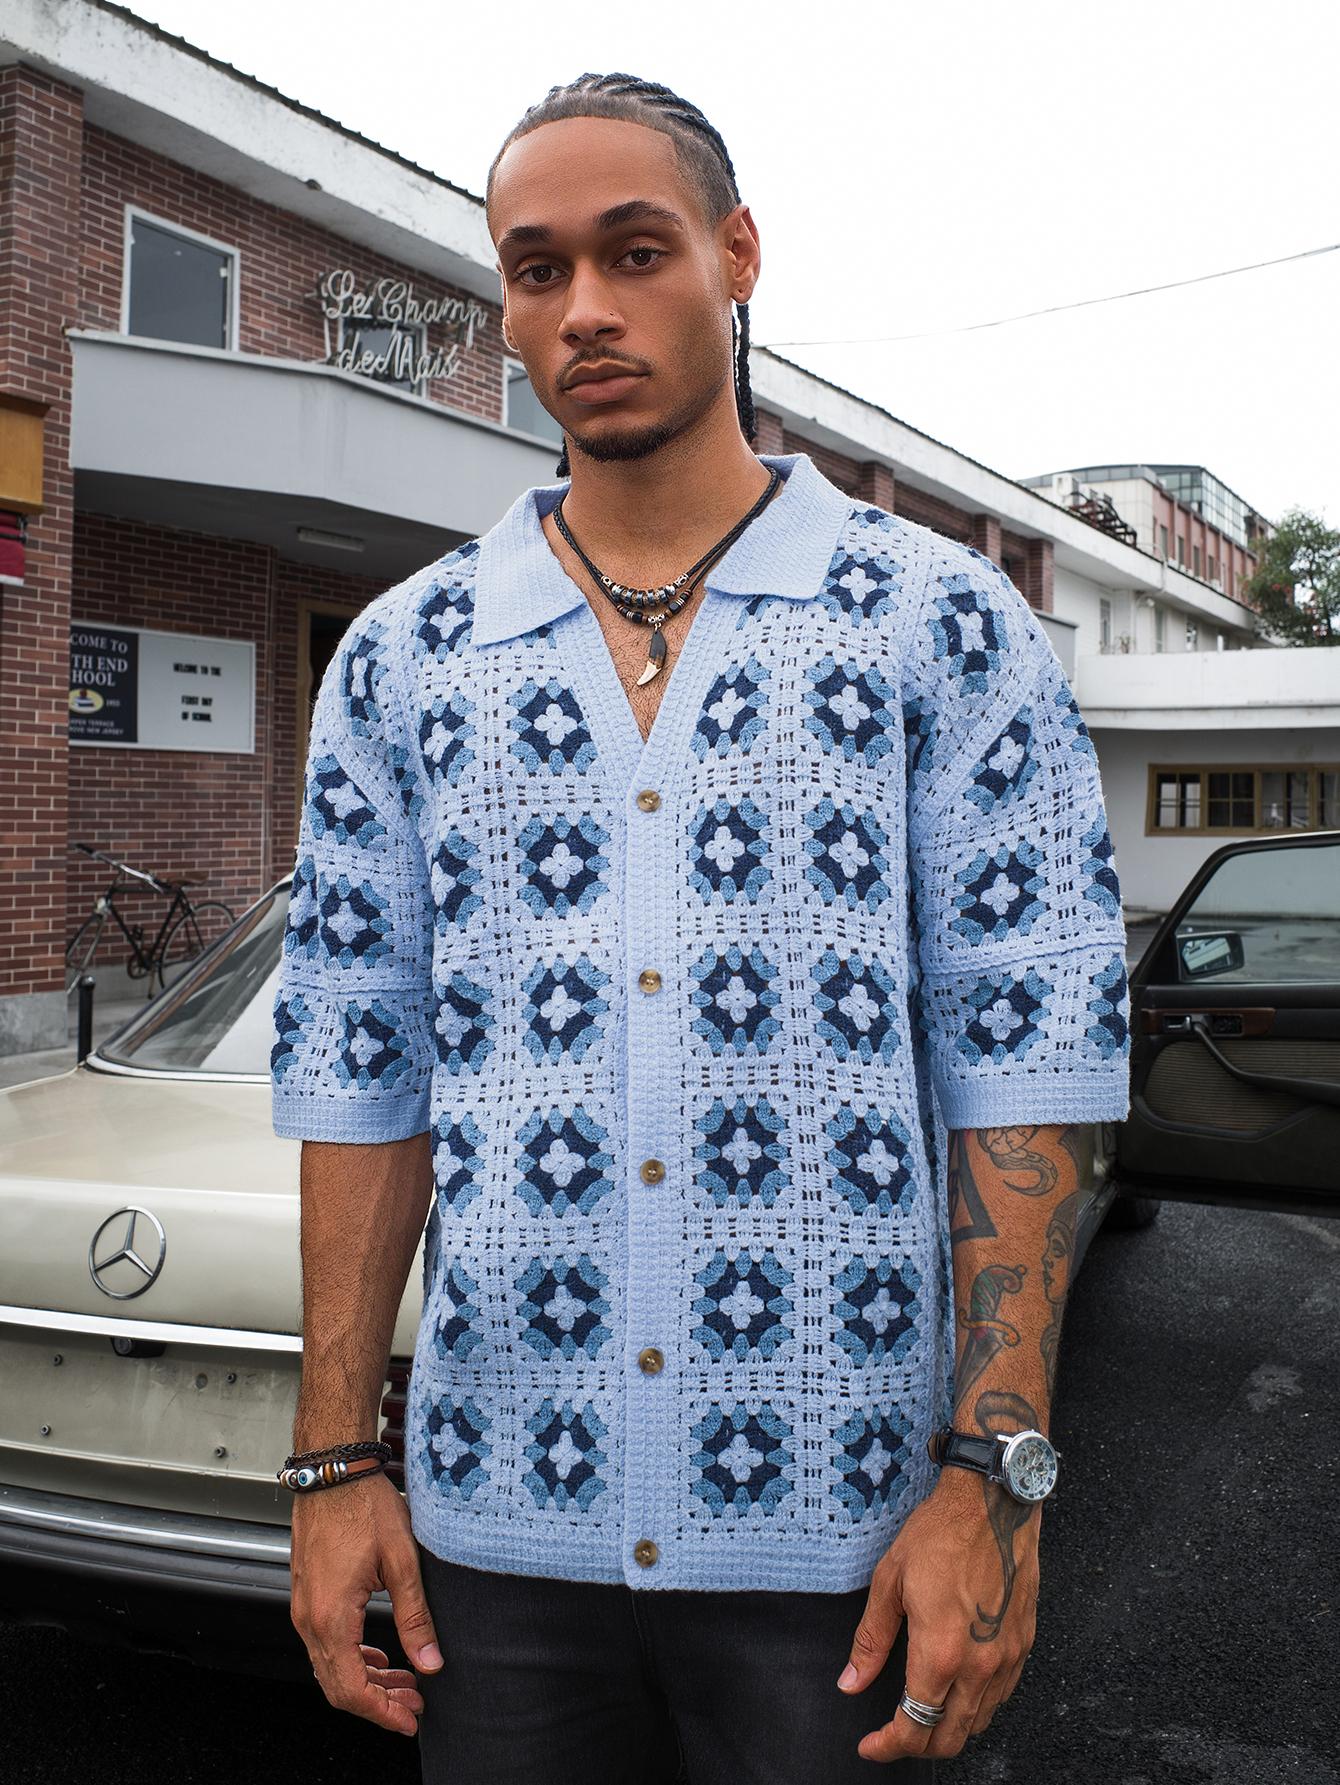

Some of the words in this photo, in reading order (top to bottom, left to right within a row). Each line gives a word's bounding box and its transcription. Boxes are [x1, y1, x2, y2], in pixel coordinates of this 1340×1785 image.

[325, 270, 373, 319] Le
[377, 278, 488, 349] Champ
[110, 639, 128, 654] TO
[97, 656, 127, 672] END
[72, 669, 116, 687] HOOL
